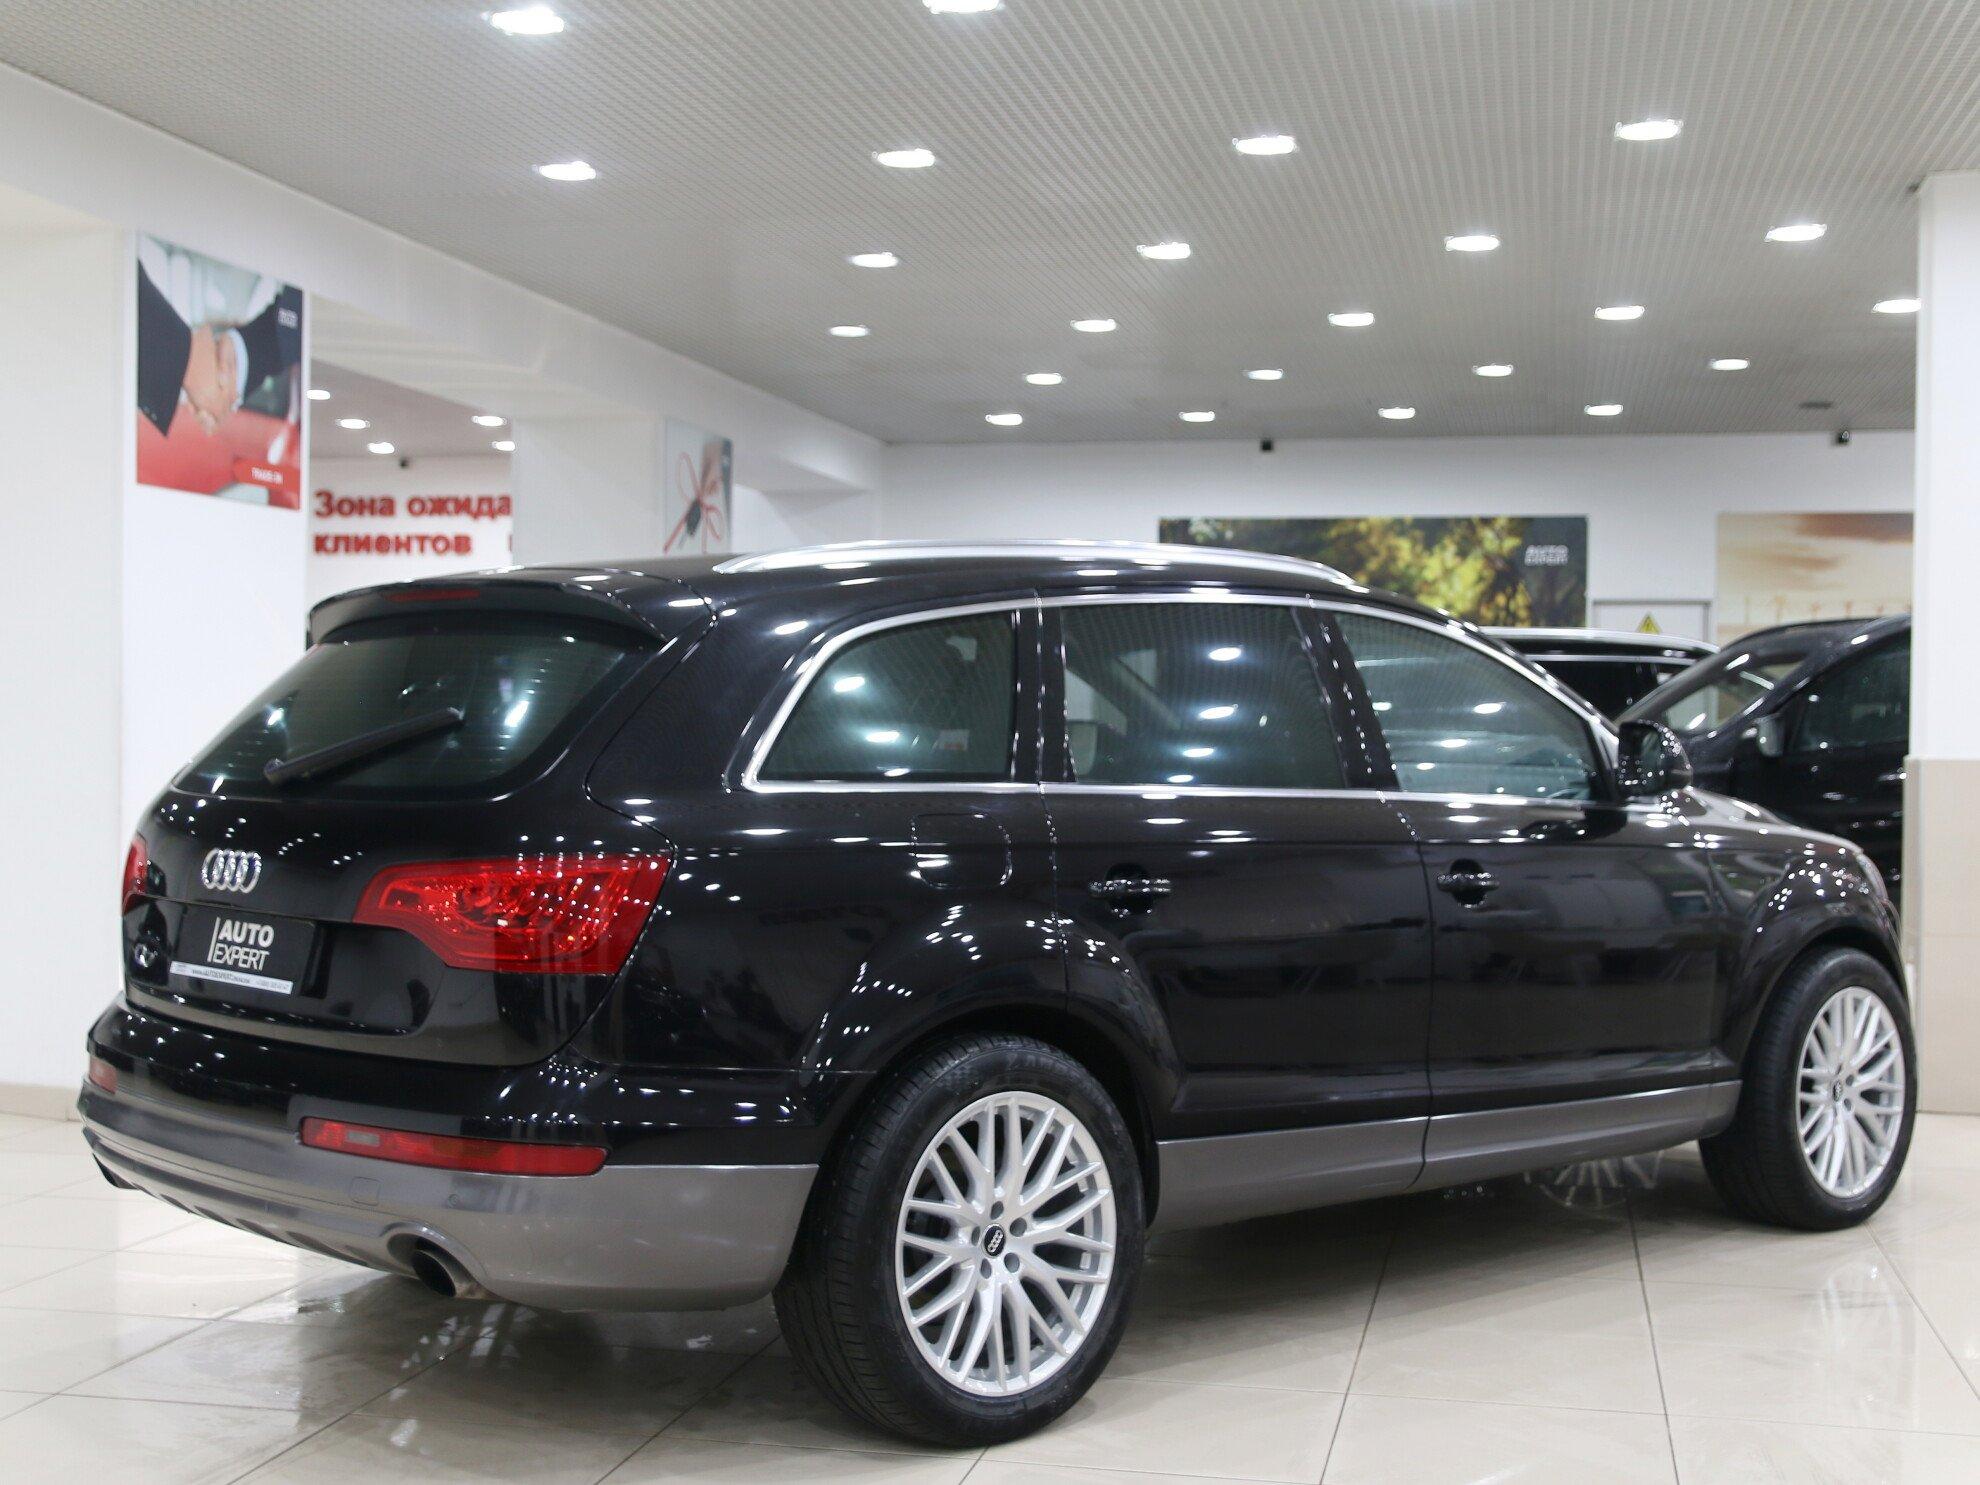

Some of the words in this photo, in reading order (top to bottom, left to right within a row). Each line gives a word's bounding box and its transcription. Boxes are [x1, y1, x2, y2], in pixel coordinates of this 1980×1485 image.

[314, 490, 395, 518] Зона
[314, 534, 471, 554] клиентов
[218, 919, 275, 948] AUTO
[212, 942, 270, 971] EXPERT
